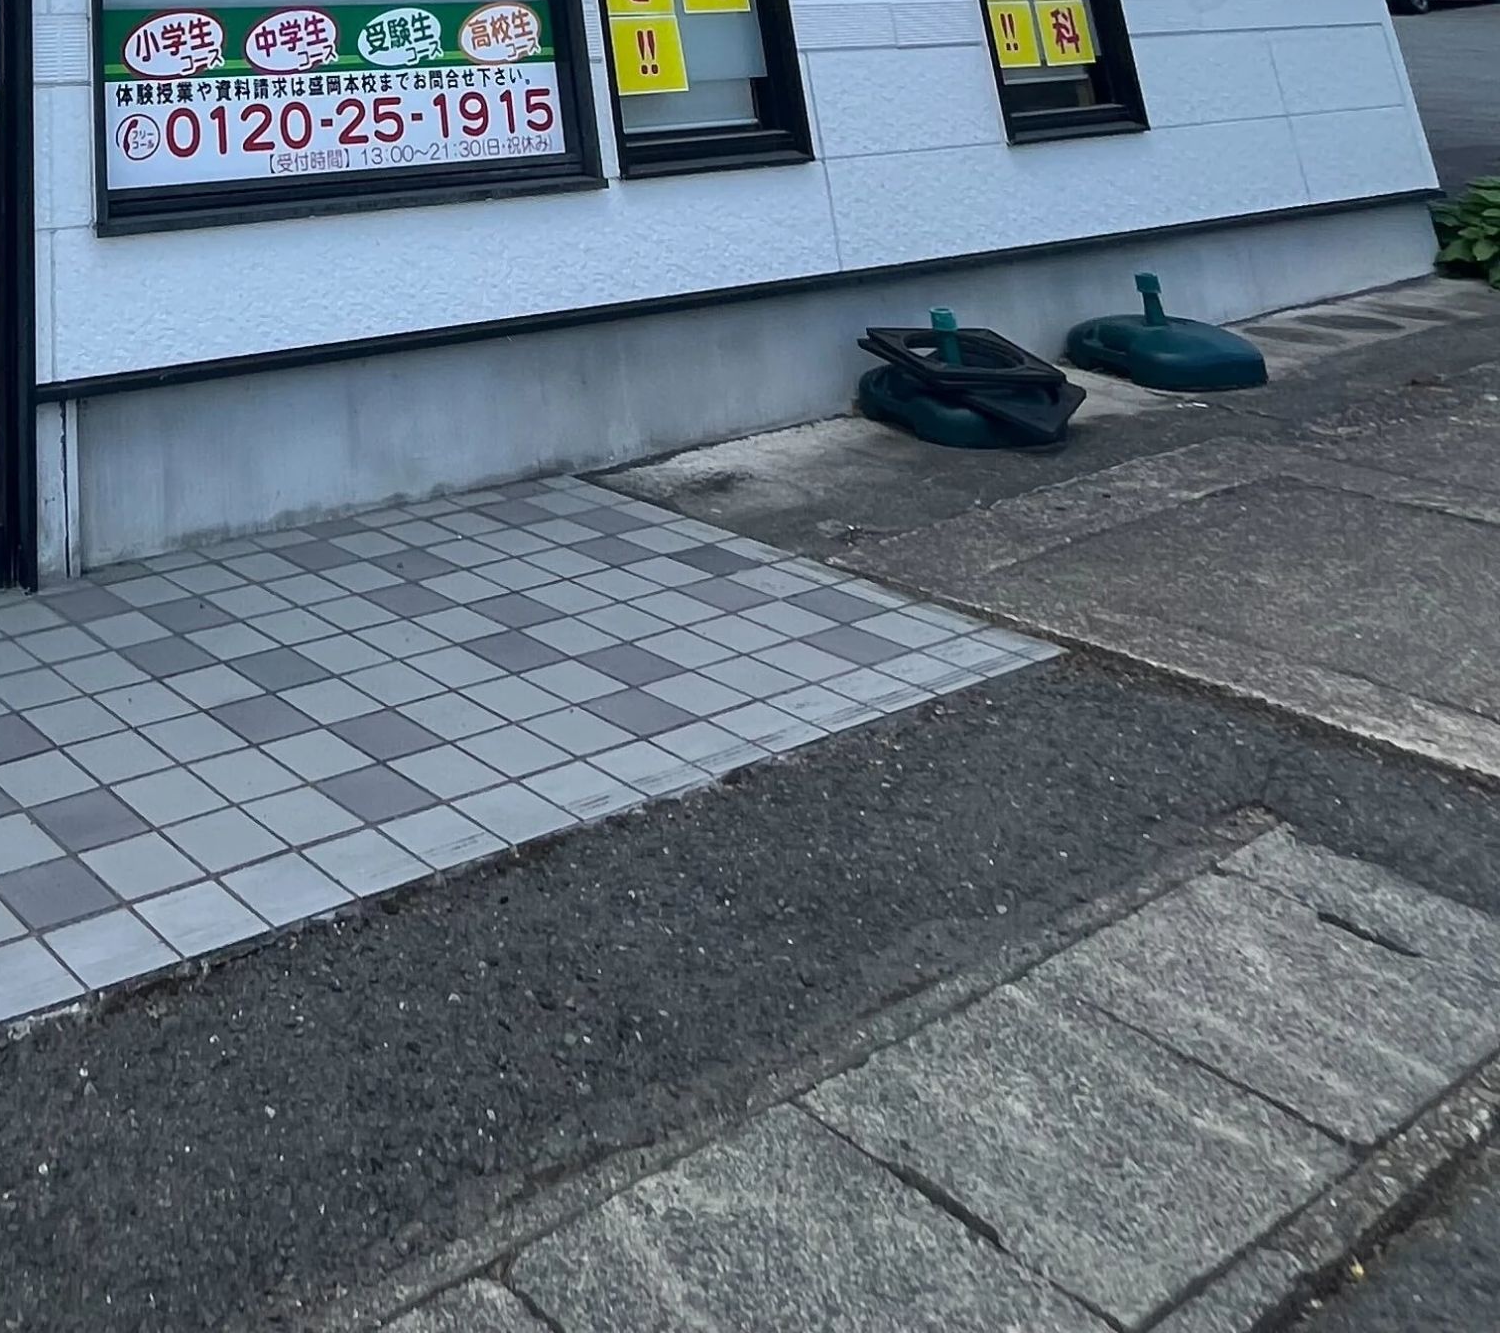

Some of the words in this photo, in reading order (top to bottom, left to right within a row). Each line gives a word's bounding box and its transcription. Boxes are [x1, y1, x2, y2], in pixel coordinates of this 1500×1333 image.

[135, 17, 215, 63] 小学生
[254, 14, 329, 58] 中学生
[365, 11, 435, 55] 受験生
[467, 9, 533, 51] 高校生
[506, 38, 540, 59] コース
[180, 47, 224, 73] コース
[297, 44, 337, 68] コース
[405, 40, 442, 63] コース
[115, 67, 531, 107] 体験授業や資料請求は盛岡本校までお問合せ下さい。
[165, 88, 554, 158] 0120-25-1915
